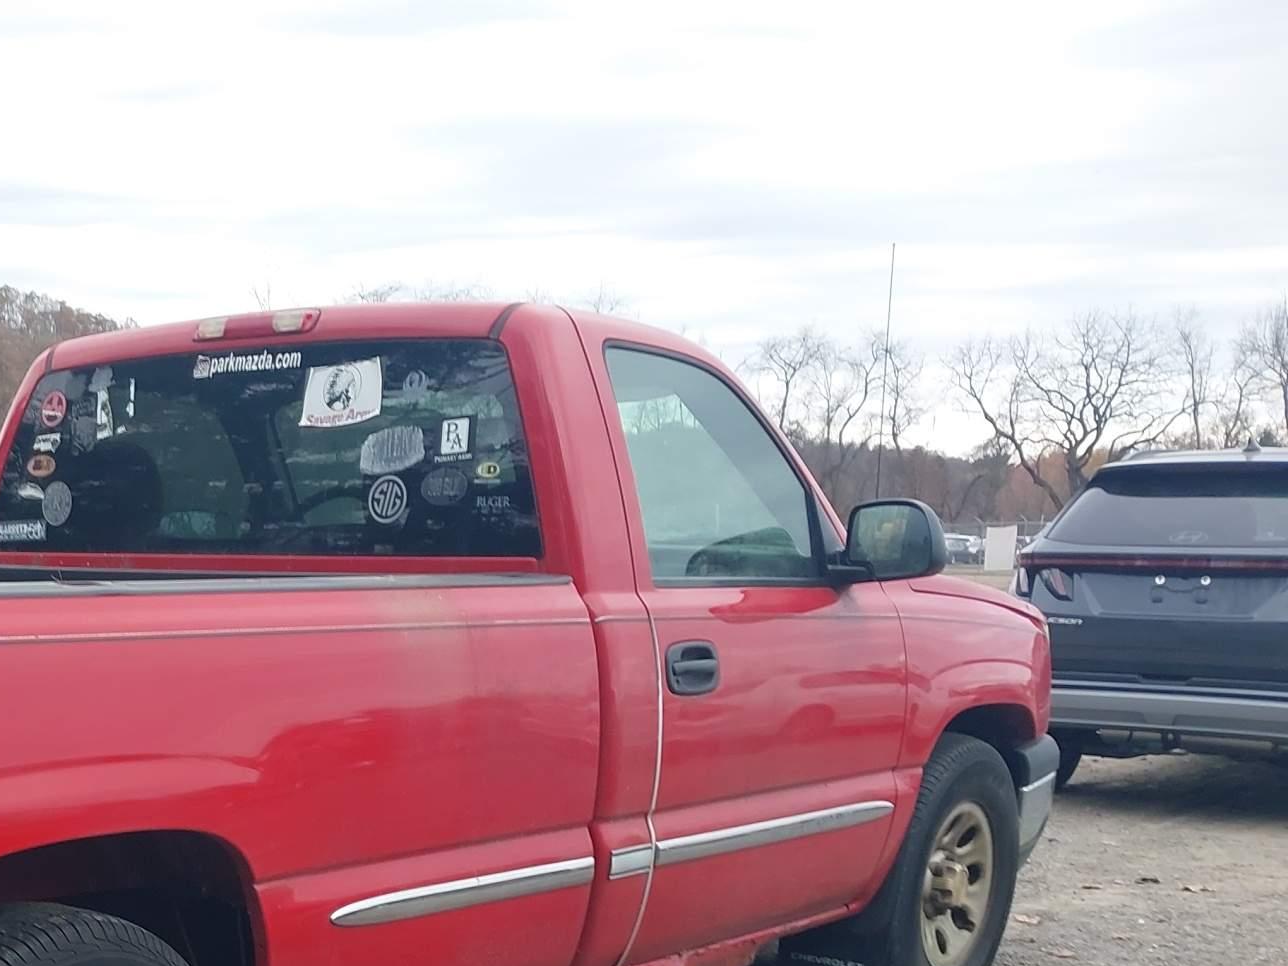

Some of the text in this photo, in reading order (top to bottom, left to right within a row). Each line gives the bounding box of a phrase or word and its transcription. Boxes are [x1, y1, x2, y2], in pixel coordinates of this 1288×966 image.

[209, 349, 301, 379] parkmazda.com
[373, 481, 402, 518] SIG
[477, 495, 511, 507] RUGER
